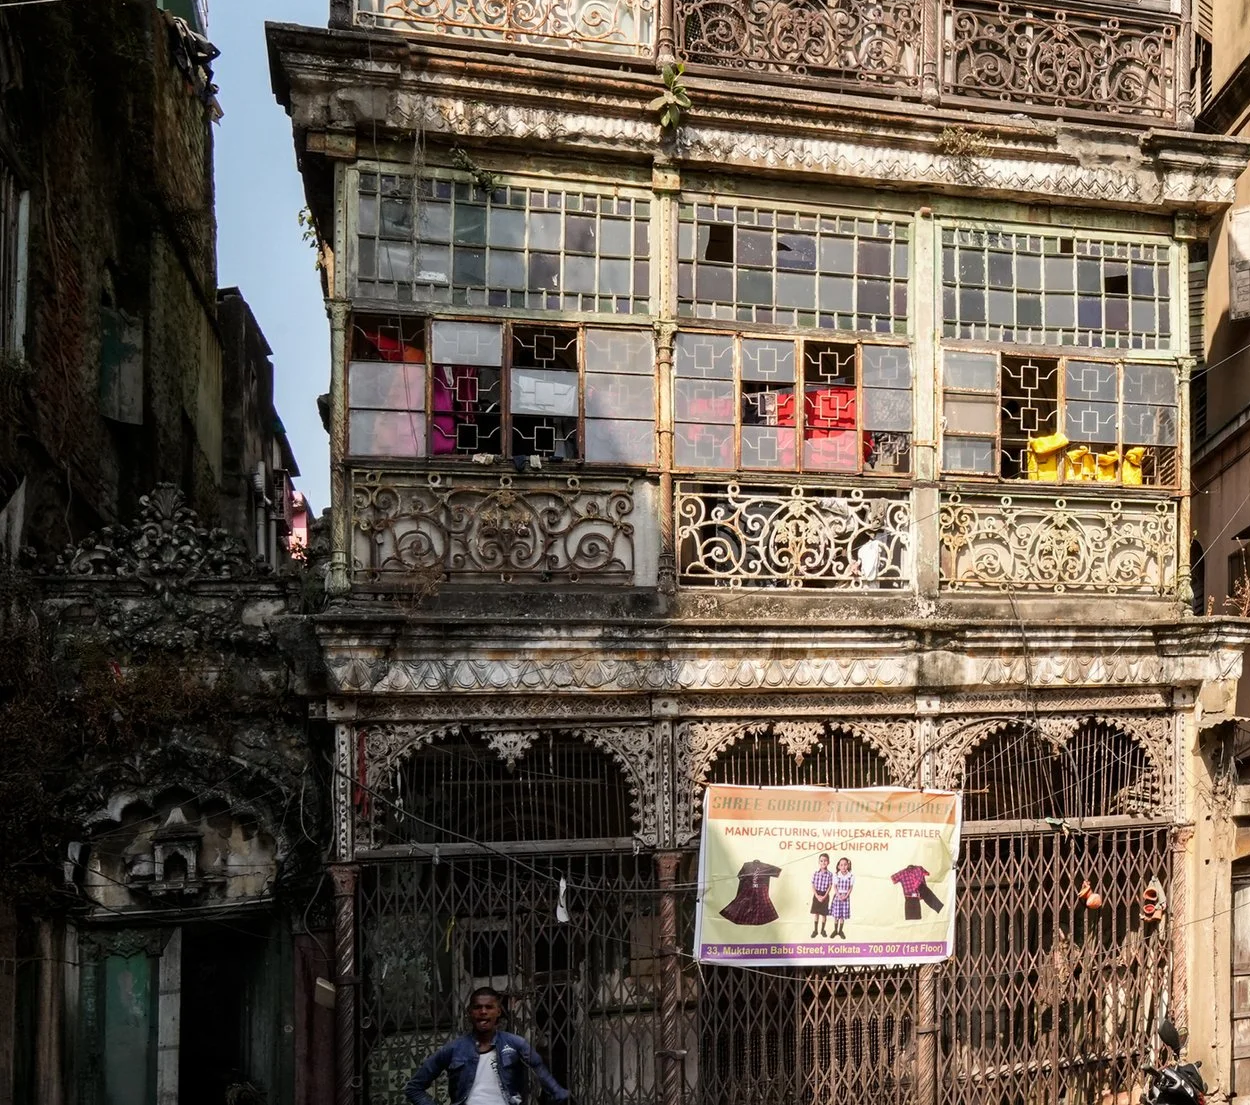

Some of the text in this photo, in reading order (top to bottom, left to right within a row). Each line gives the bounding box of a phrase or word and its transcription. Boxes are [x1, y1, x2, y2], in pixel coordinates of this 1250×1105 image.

[712, 796, 762, 811] SHREE
[767, 798, 821, 813] GOBIND
[725, 827, 941, 839] MANUFACTURING, WHOLESALER, RETAILER
[779, 841, 889, 851] OF SCHOOL UNIFORM
[706, 946, 720, 956] 33,
[723, 946, 768, 955] Muktaram
[770, 946, 794, 955] Babu
[797, 945, 826, 956] Street,
[828, 944, 860, 954] Kolkata
[869, 944, 884, 953] 700
[886, 944, 901, 953] 007
[902, 943, 919, 955] (1st
[920, 943, 944, 954] Floor)
